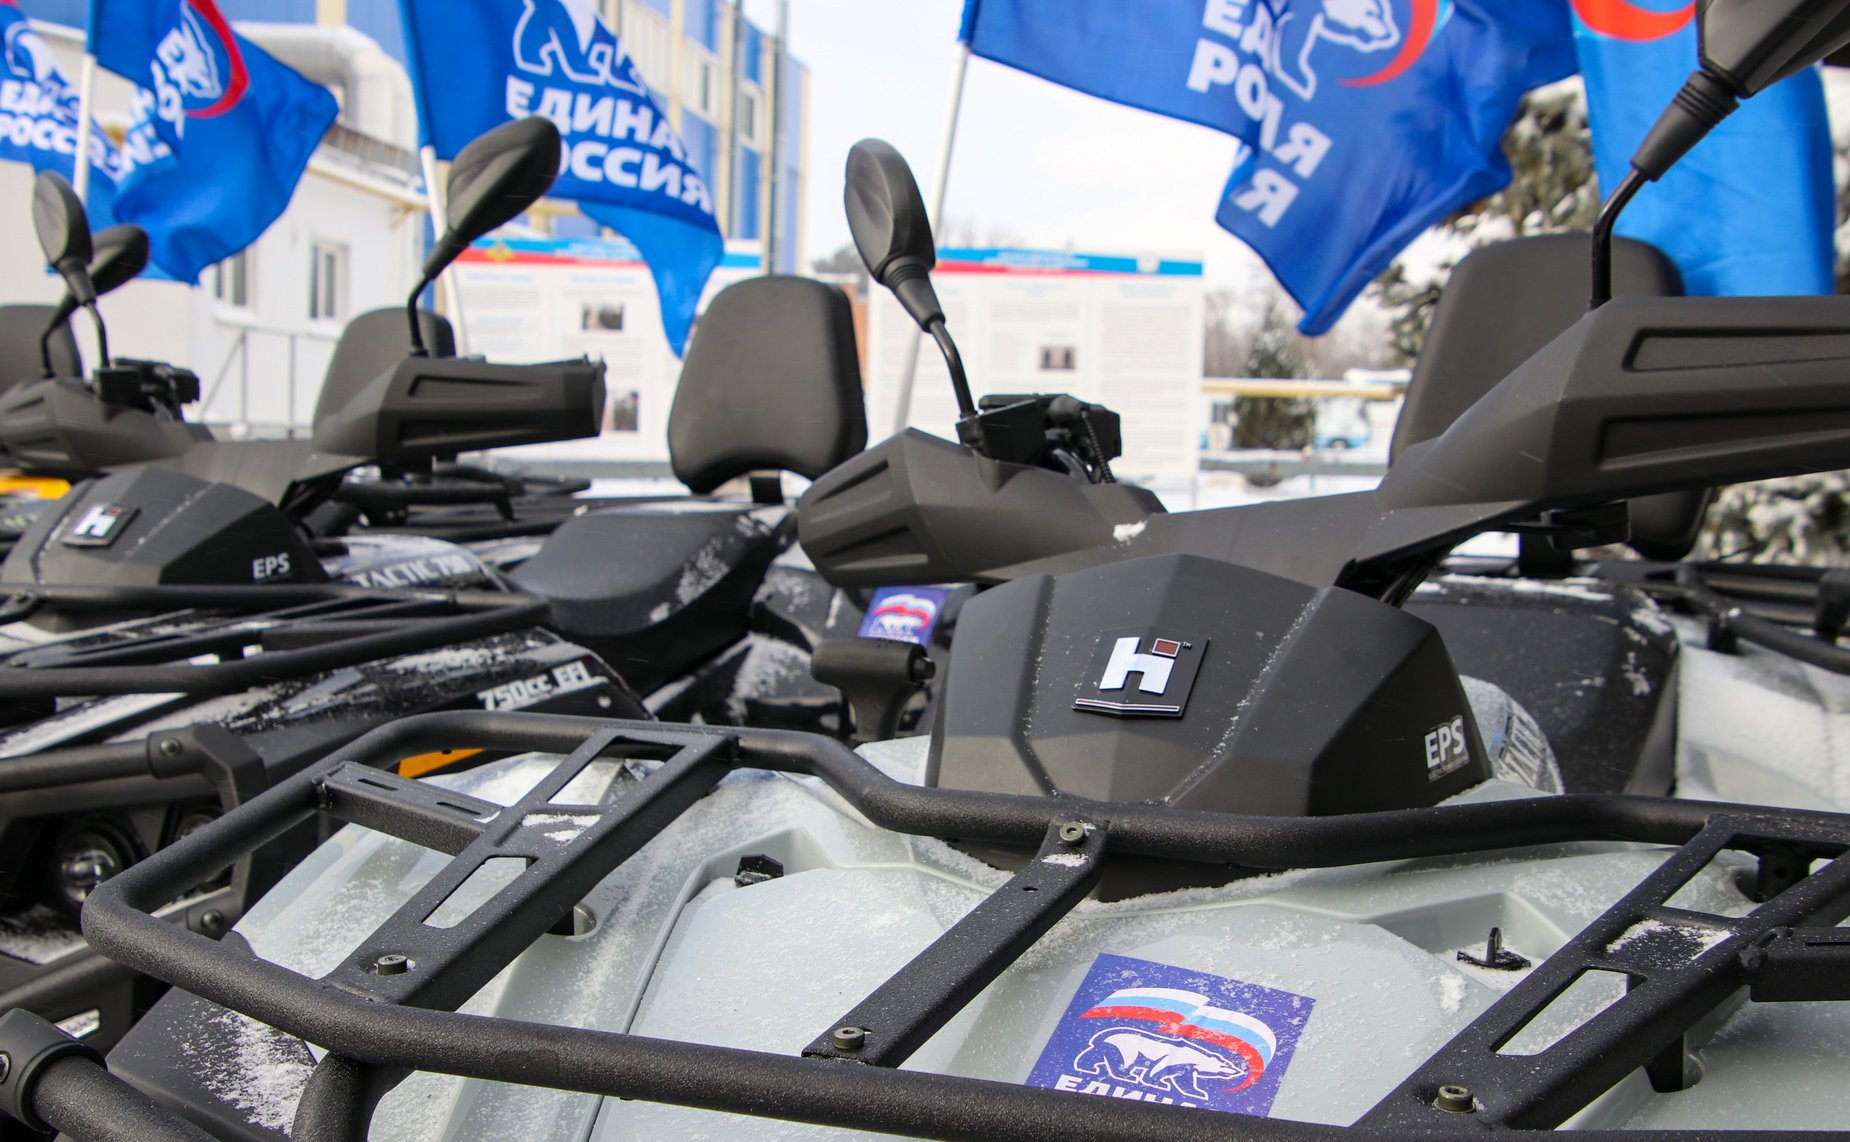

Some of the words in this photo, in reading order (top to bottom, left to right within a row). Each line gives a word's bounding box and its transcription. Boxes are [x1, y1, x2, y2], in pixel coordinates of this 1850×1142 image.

[506, 75, 688, 162] ЕДИНА
[559, 138, 716, 216] ССИЯ
[252, 553, 291, 580] EPS
[1424, 718, 1466, 769] EPS
